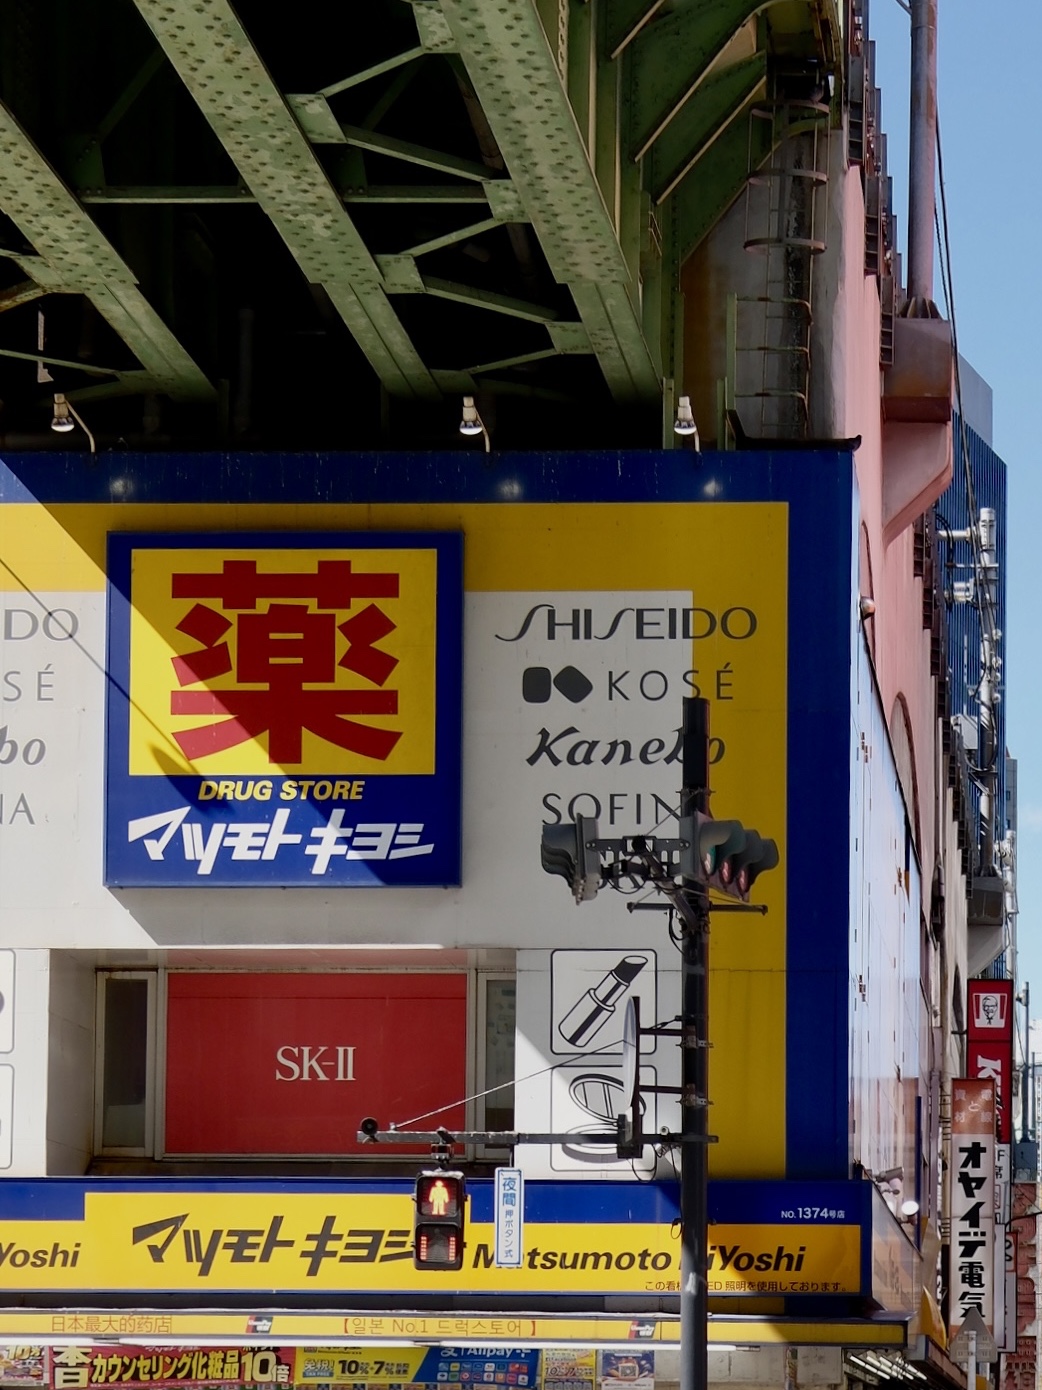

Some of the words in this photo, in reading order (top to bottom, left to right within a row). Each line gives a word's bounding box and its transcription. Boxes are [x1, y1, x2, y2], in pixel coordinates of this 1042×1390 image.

[494, 604, 758, 641] SHISEIDO
[170, 560, 404, 764] 薬
[608, 663, 734, 701] KOSÉ
[198, 780, 272, 801] DRUG
[280, 780, 366, 801] STORE
[541, 793, 682, 827] SOFIN
[128, 805, 435, 875] マツモトキヨシ
[275, 1046, 356, 1081] SK-II
[501, 1176, 517, 1207] 夜間
[503, 1209, 515, 1260] 押ボタン式
[957, 1142, 988, 1319] オヤイデ電気
[679, 1245, 807, 1272] iYoshi
[51, 1315, 171, 1334] 日本最大的药店
[91, 1350, 240, 1383] カウンセリング化粧品
